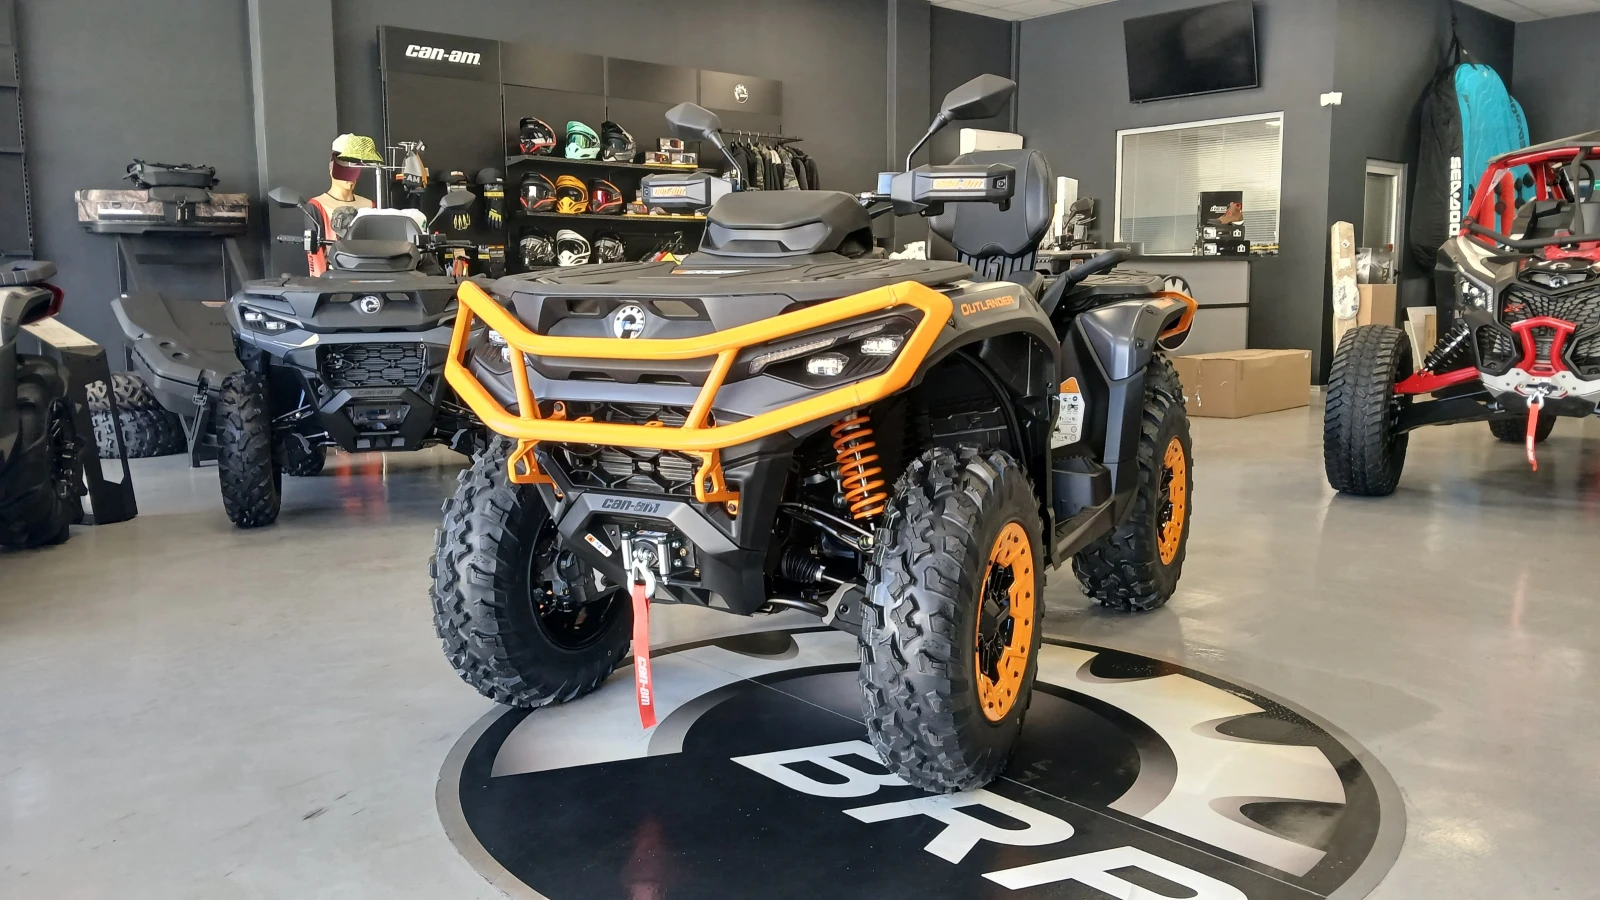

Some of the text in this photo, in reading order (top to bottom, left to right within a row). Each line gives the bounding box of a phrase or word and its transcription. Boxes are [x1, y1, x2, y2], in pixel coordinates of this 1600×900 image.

[405, 44, 481, 66] can-am
[960, 294, 1015, 316] OUTLANDER
[601, 498, 661, 514] can-am
[637, 655, 650, 706] can-am
[730, 740, 1249, 900] BRP
